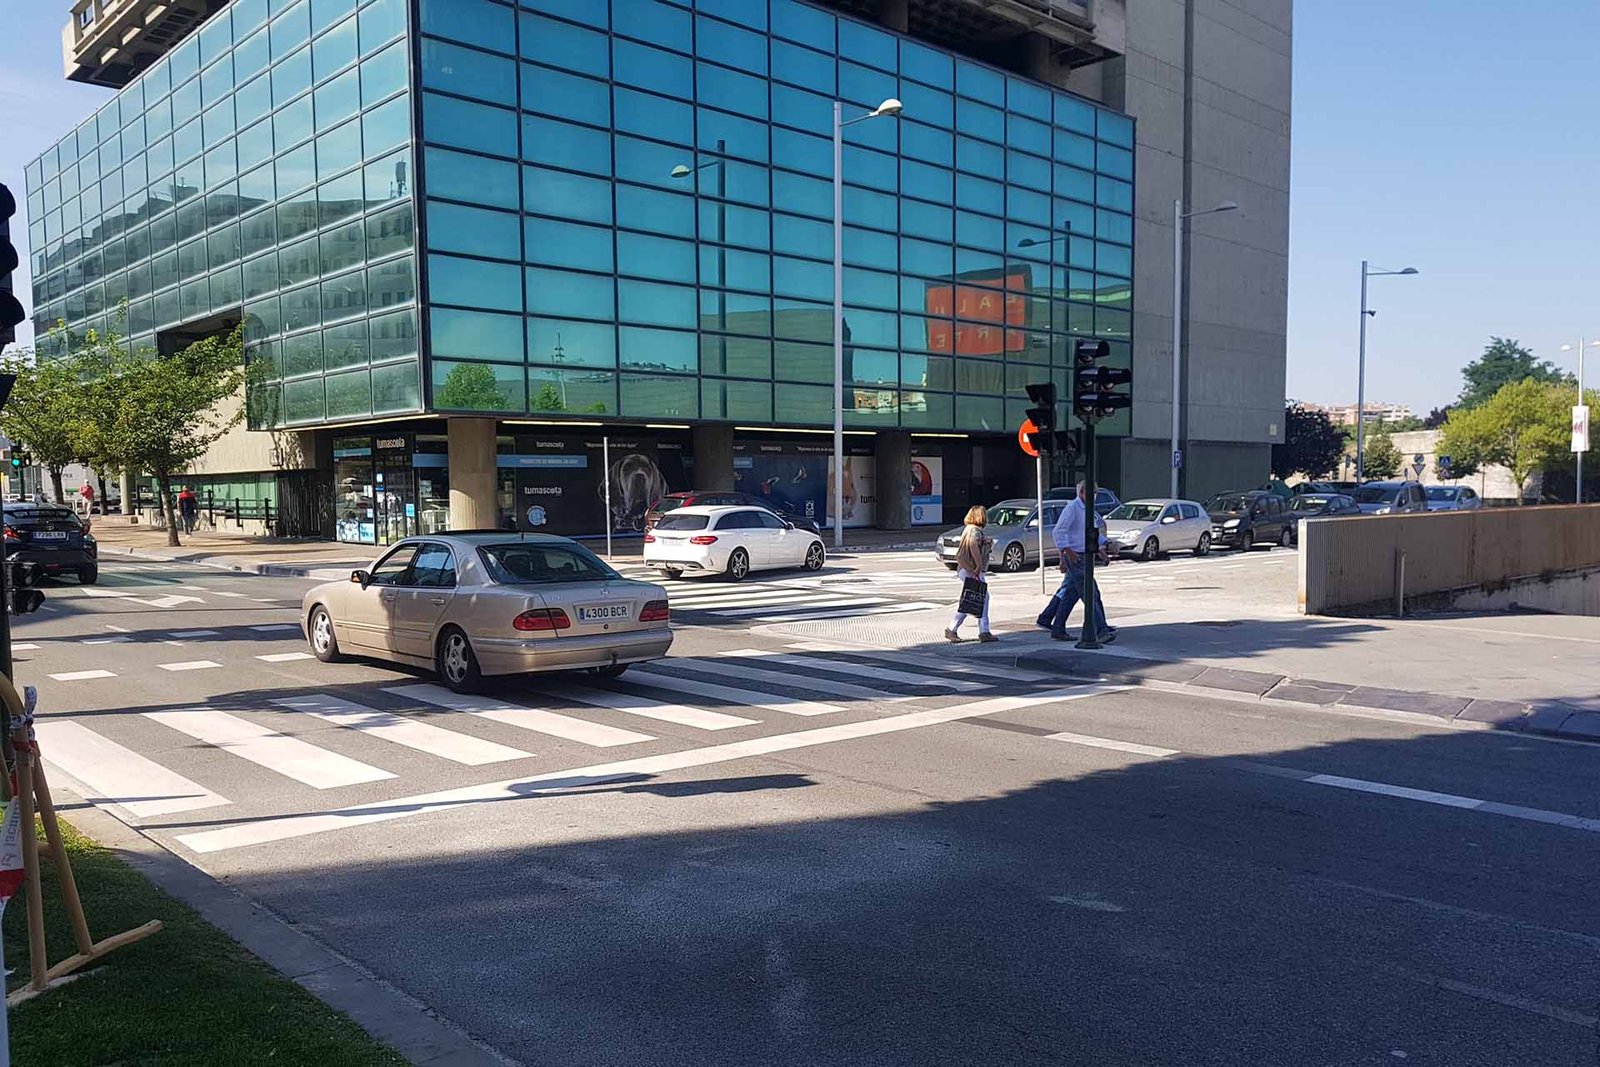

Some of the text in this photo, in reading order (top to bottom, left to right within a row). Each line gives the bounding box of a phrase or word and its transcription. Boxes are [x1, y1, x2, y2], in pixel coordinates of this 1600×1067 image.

[524, 486, 562, 495] tumascota
[586, 606, 627, 618] 4300 BCR
